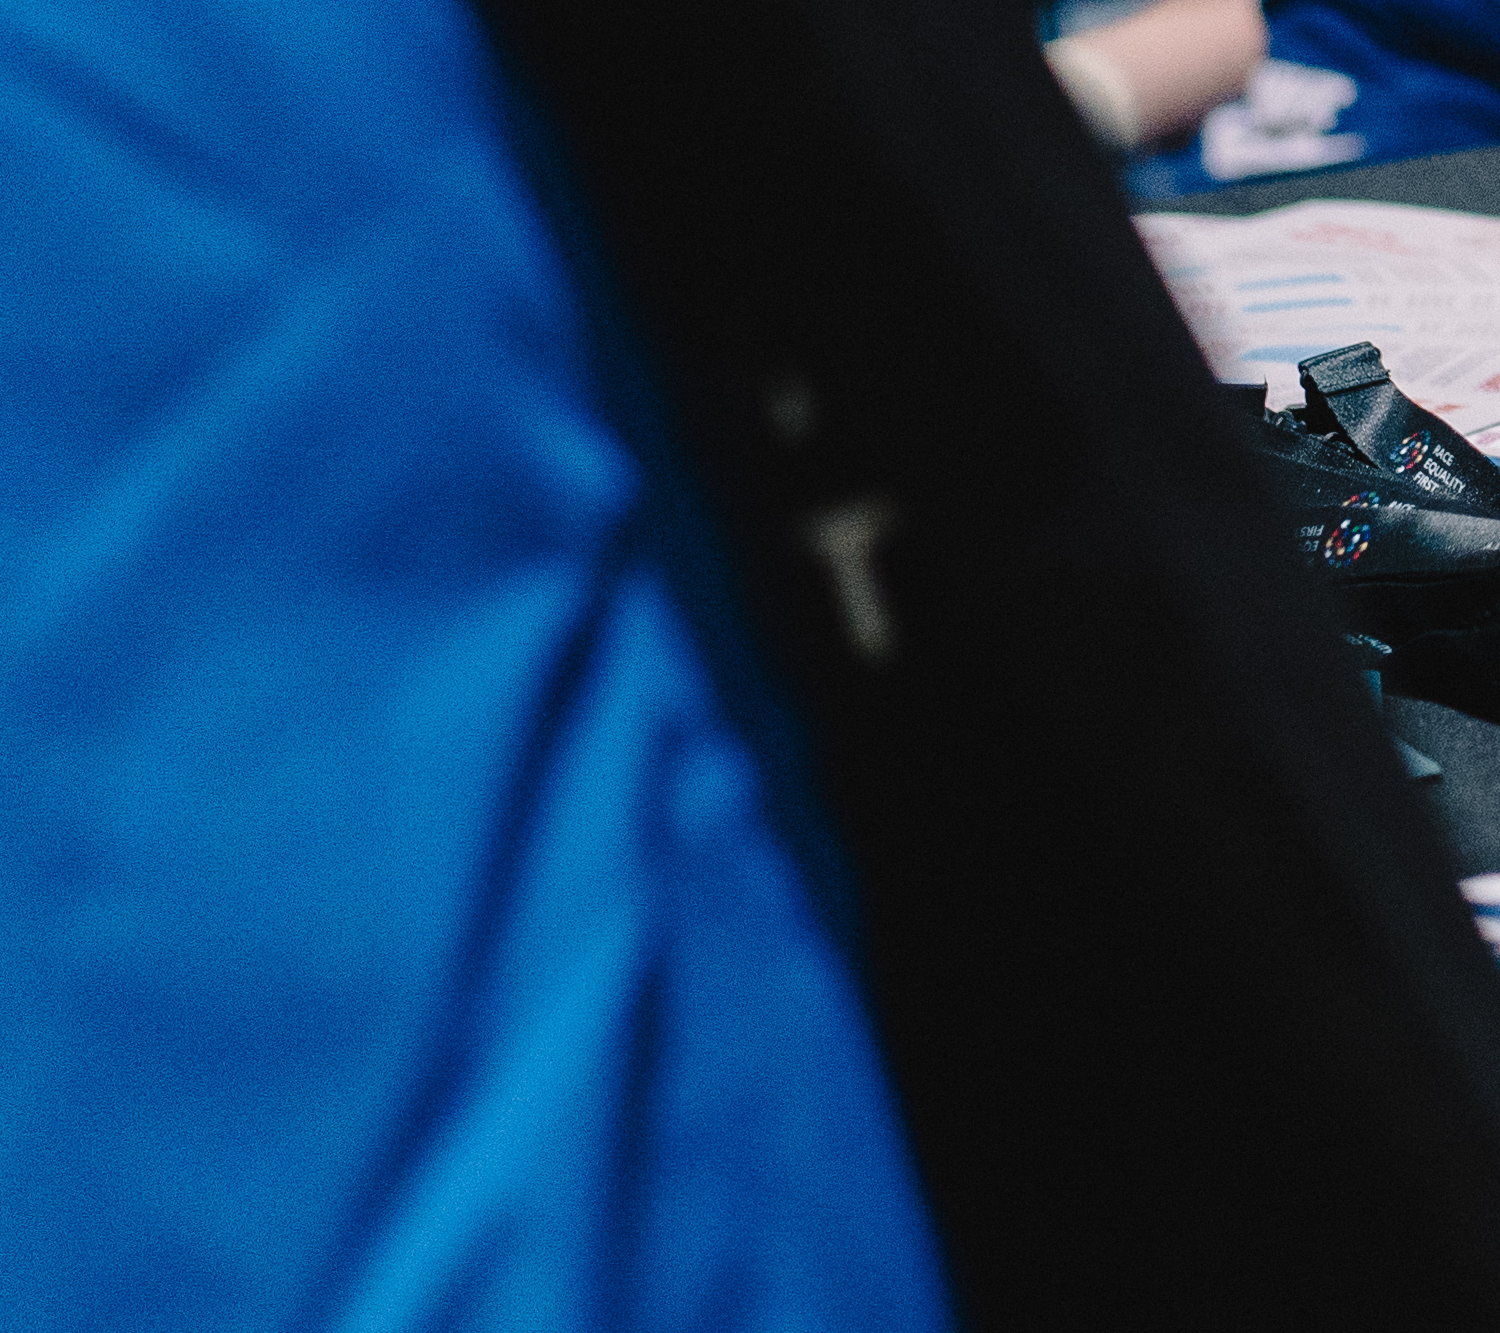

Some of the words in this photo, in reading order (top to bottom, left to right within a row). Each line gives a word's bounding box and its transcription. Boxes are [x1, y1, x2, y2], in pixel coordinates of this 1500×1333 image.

[1432, 444, 1455, 467] RACE
[1413, 471, 1440, 493] FIRST
[1423, 458, 1466, 493] EQUALITY
[1300, 524, 1325, 537] FIRS
